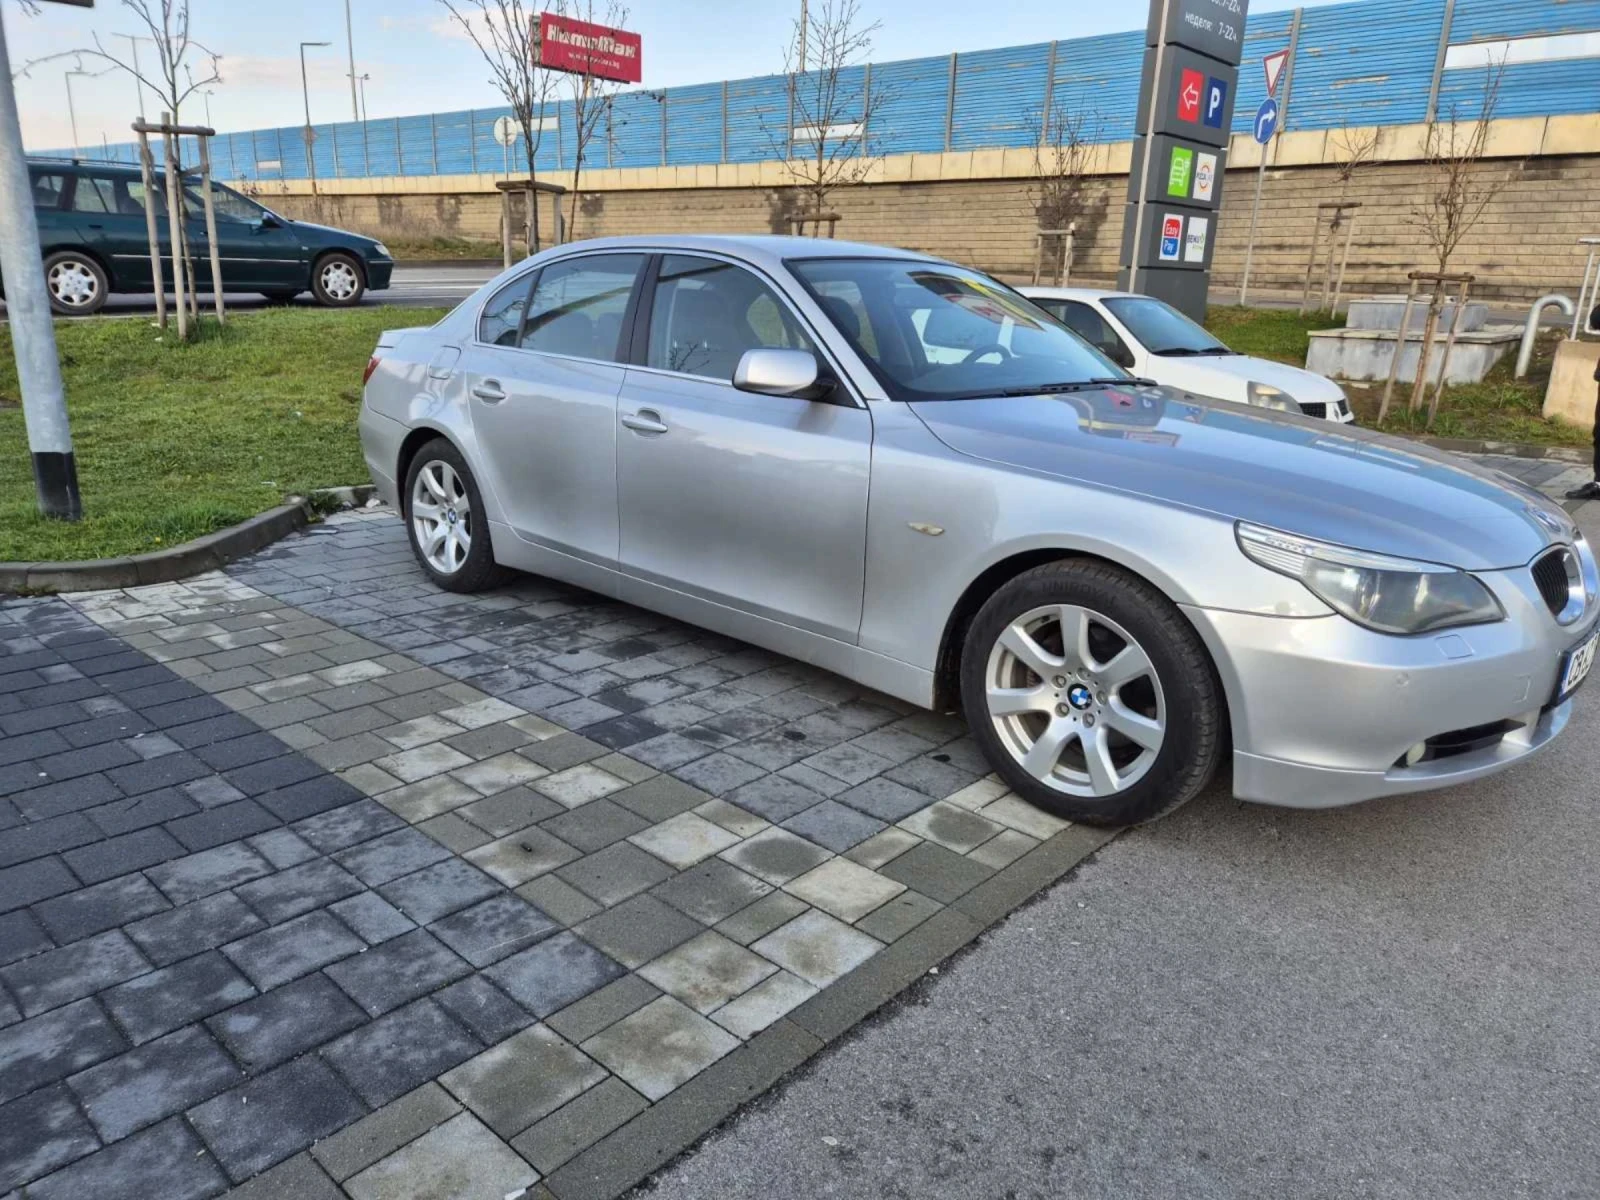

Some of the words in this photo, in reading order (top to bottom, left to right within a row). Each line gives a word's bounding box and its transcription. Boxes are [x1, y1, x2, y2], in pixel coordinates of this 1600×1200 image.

[1208, 86, 1220, 118] P
[1165, 223, 1178, 236] Easy
[1163, 239, 1175, 253] Pay
